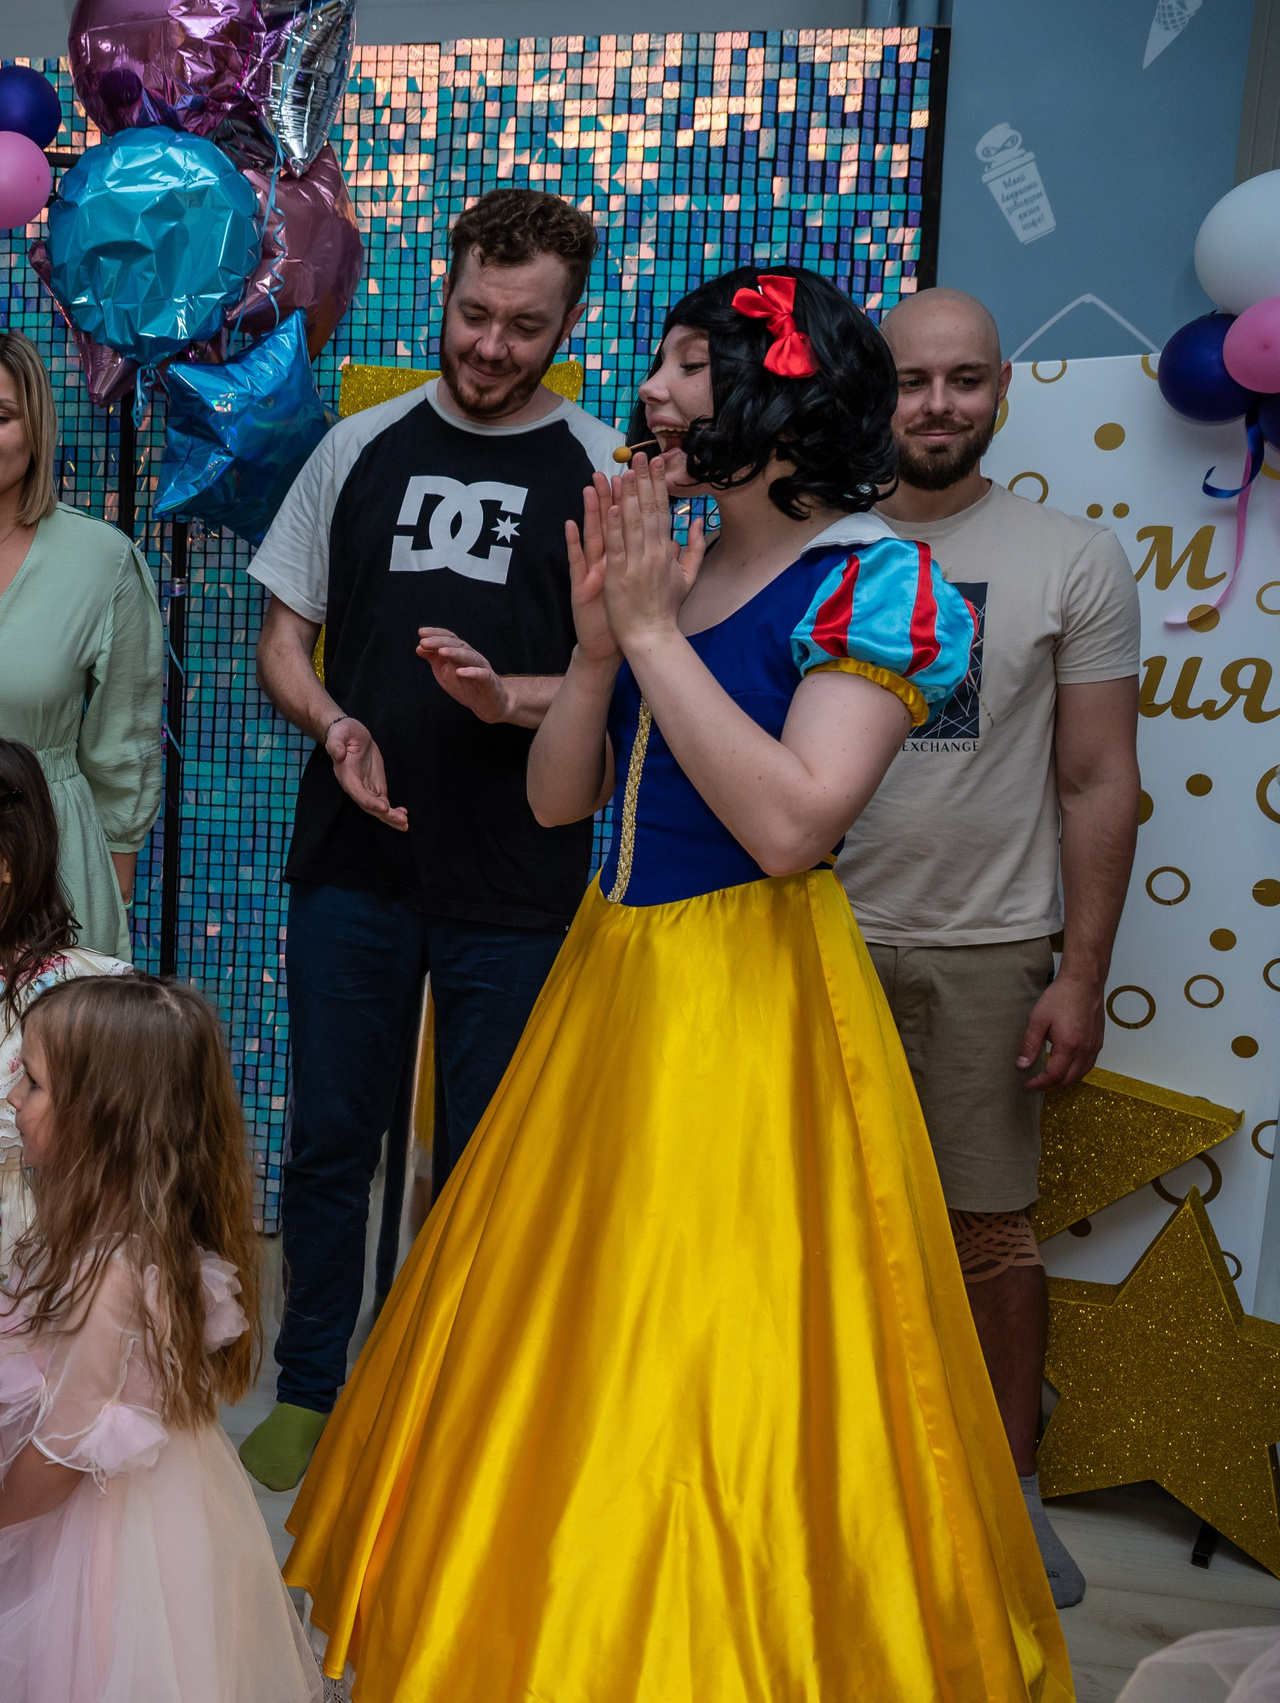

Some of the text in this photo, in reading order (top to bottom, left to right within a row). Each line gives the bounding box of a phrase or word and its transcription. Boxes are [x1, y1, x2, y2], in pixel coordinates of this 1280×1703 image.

[389, 475, 528, 585] DC
[1138, 655, 1280, 724] ия
[902, 739, 979, 752] EXCHANGE
